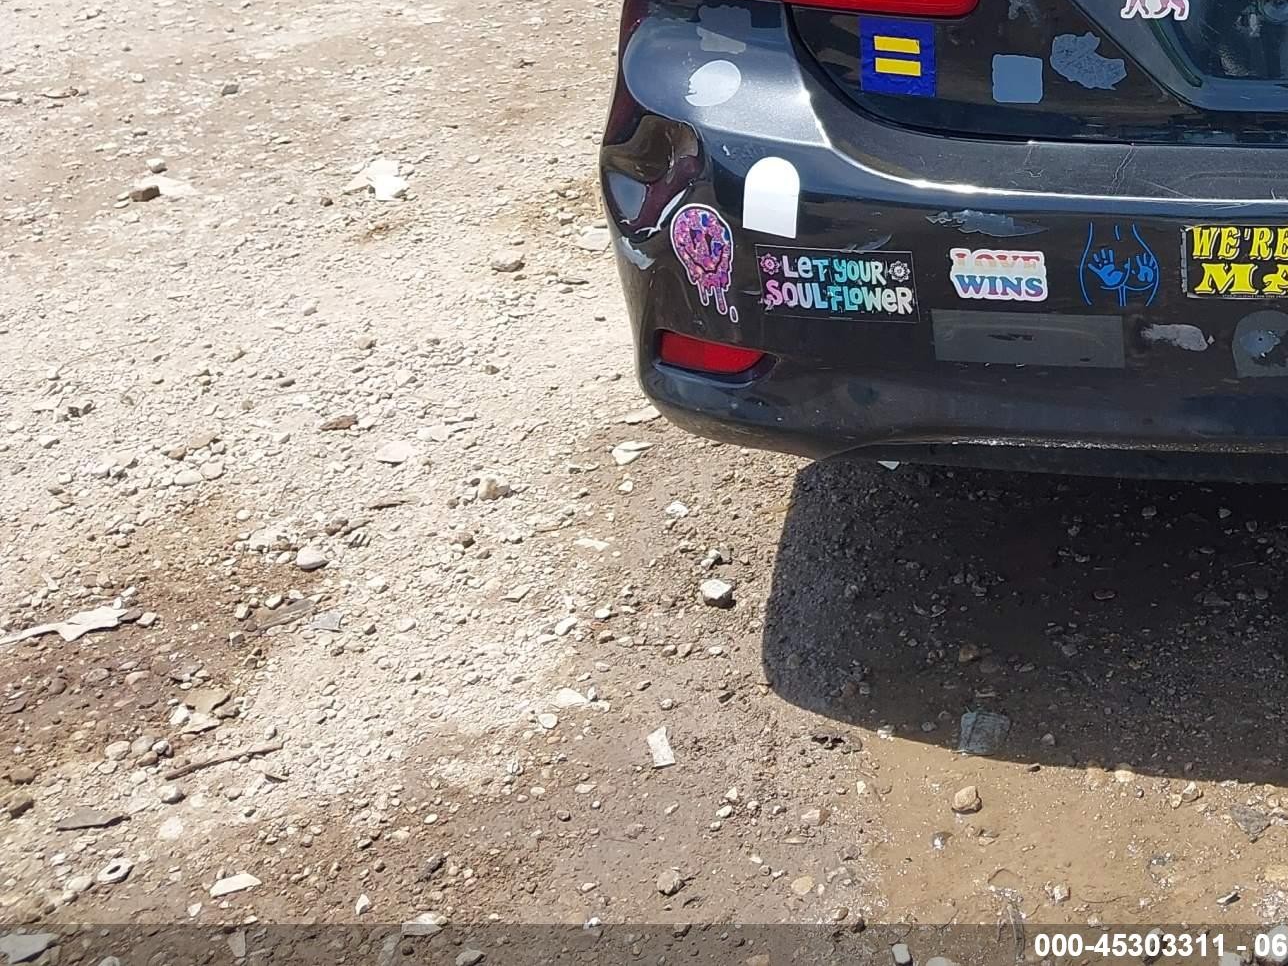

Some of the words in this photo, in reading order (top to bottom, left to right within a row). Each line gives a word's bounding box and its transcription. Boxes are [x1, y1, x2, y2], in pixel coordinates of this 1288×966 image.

[833, 259, 887, 285] YOUR
[765, 279, 828, 309] SOUL
[955, 274, 1044, 297] WINS
